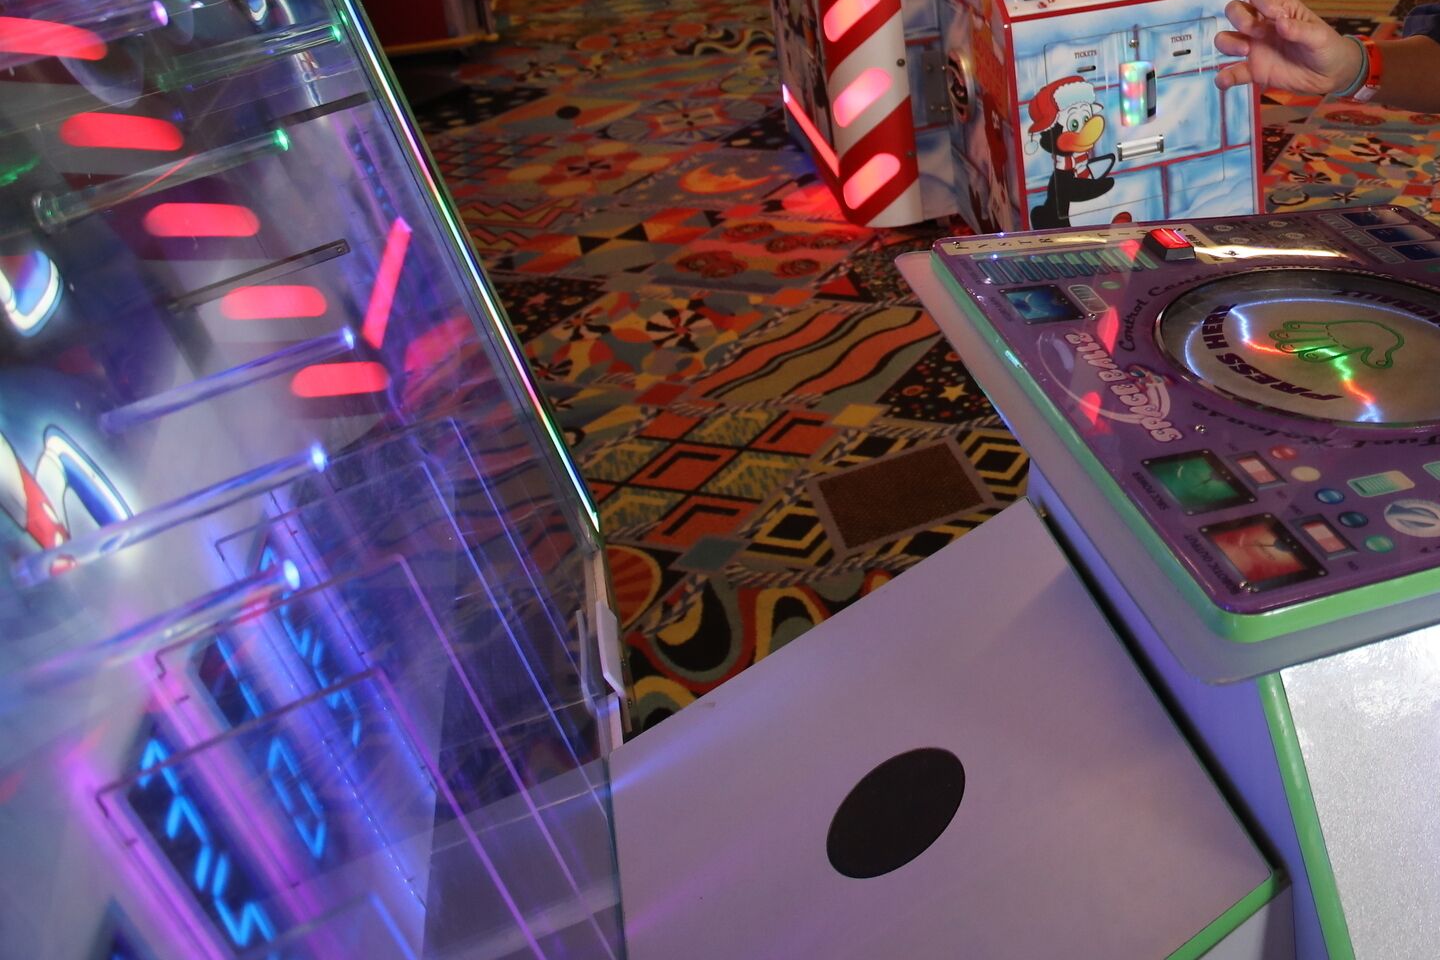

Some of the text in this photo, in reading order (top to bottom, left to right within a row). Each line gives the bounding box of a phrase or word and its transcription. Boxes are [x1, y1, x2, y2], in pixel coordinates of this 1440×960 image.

[1074, 49, 1098, 59] TICKETS
[1171, 34, 1193, 44] TICKETS
[1119, 299, 1148, 352] Control
[1216, 353, 1345, 402] PRESS
[1103, 381, 1188, 444] SPACE
